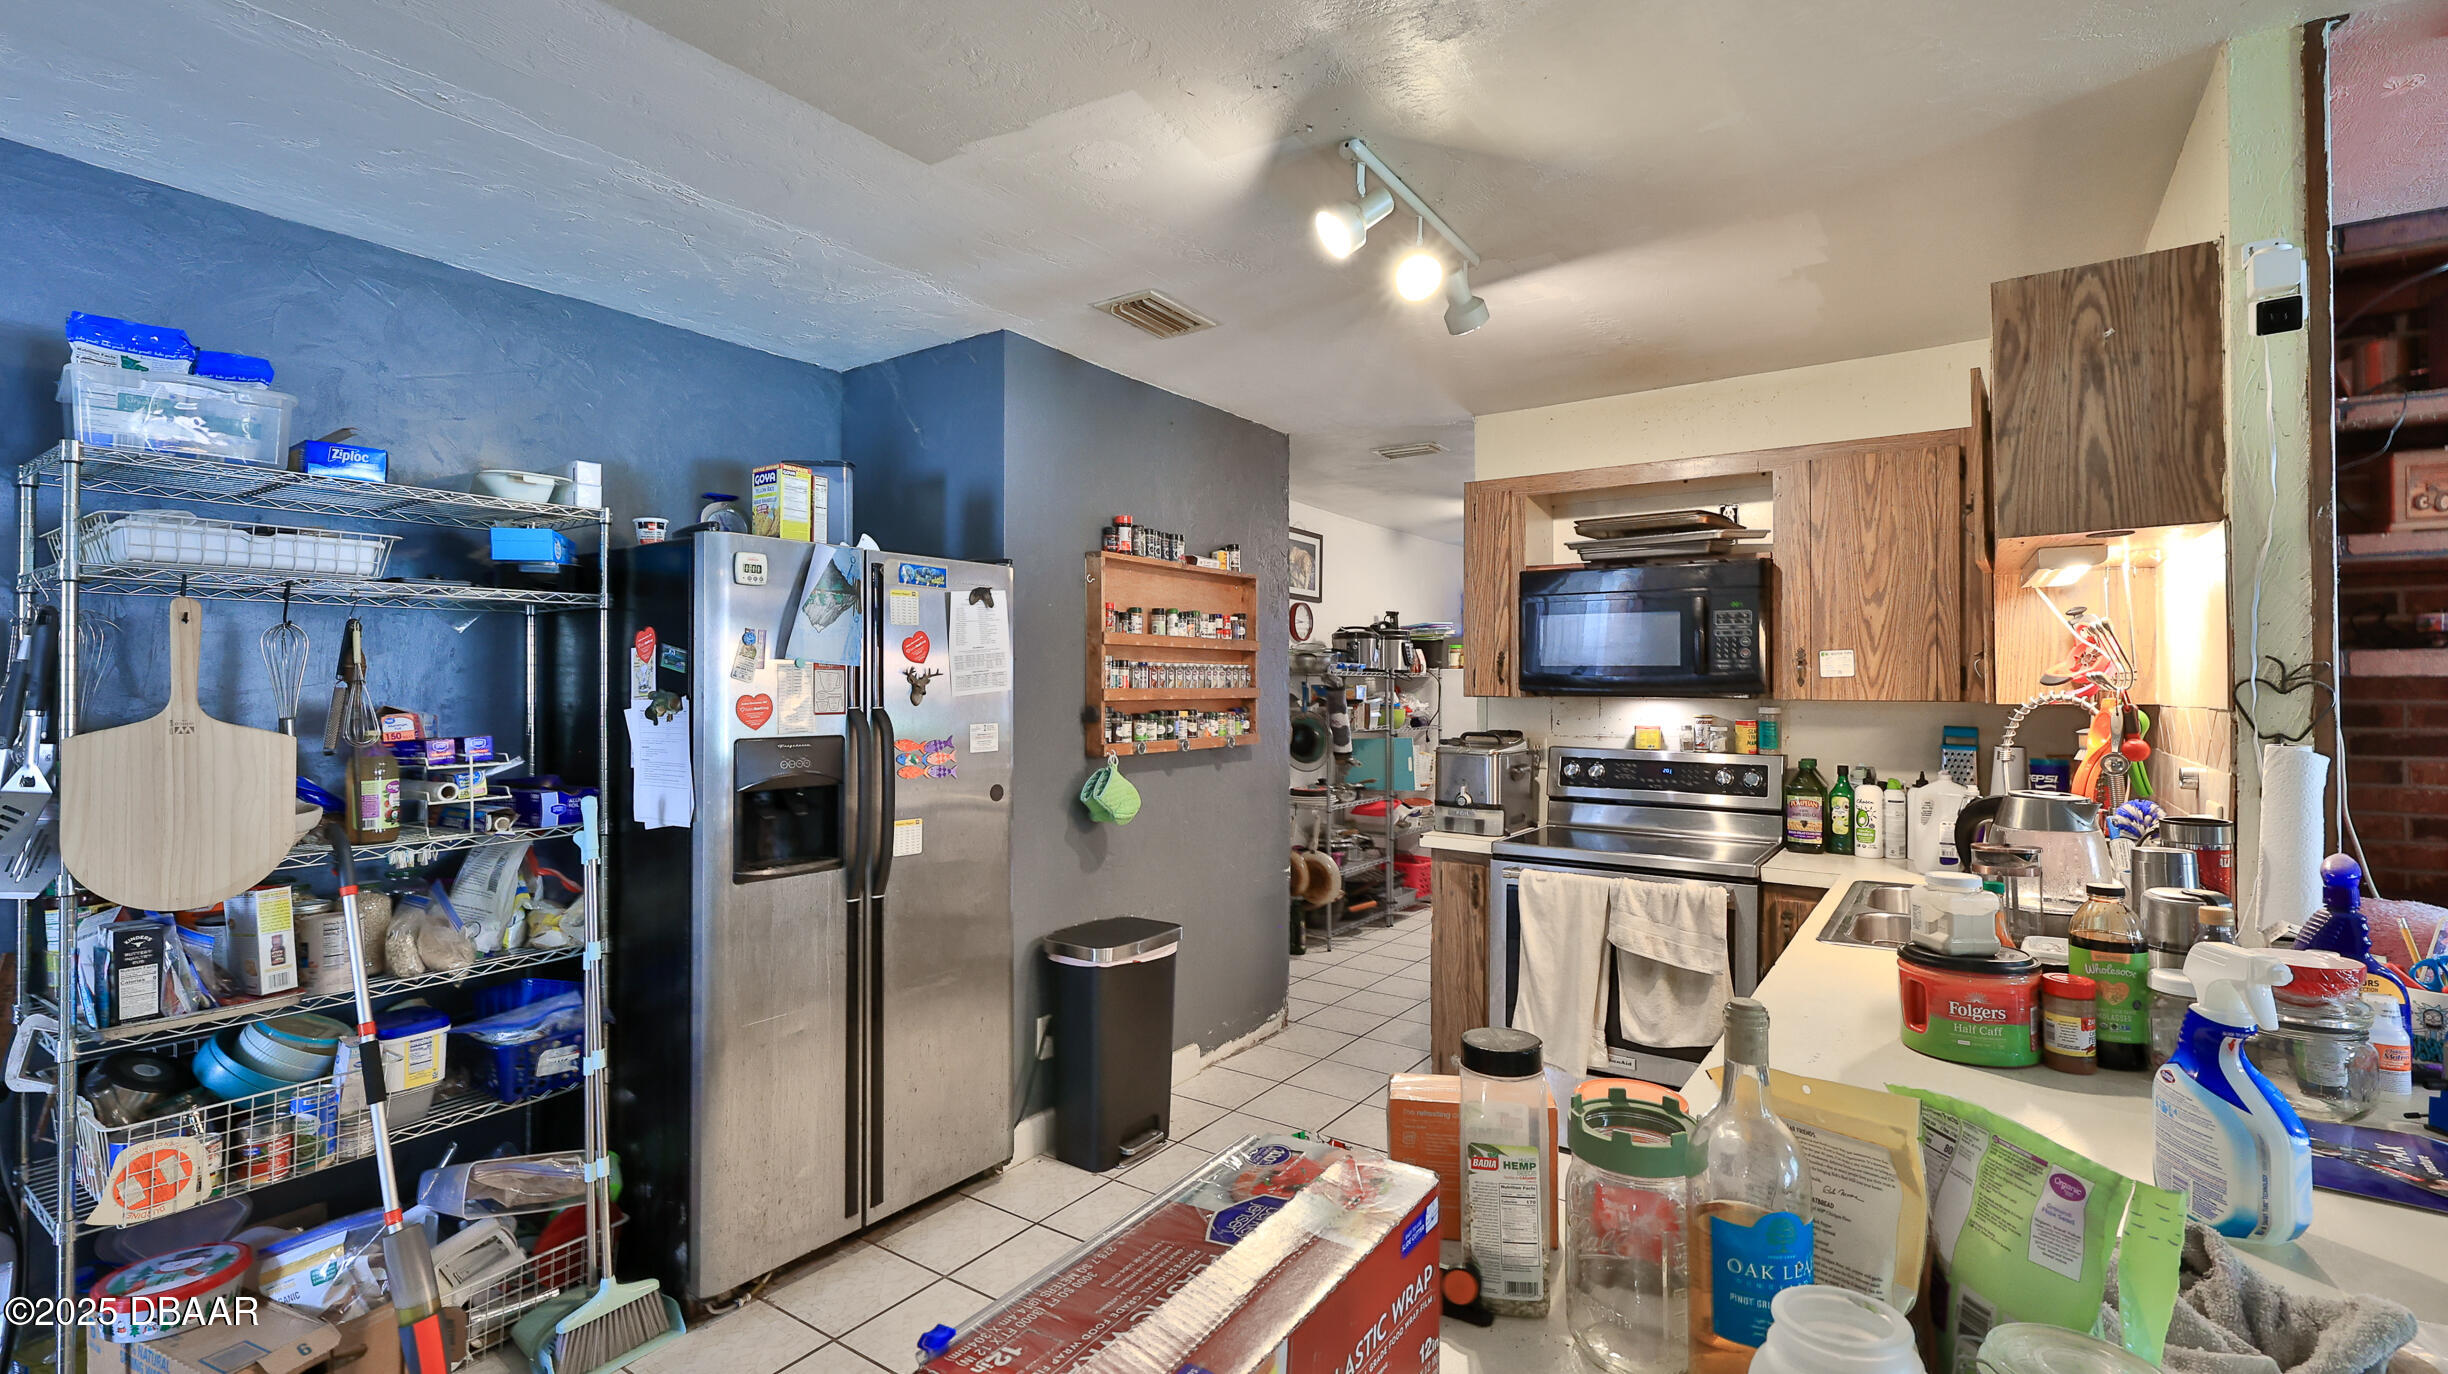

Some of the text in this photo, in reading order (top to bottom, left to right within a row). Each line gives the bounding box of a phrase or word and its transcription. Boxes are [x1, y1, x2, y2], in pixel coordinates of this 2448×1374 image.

[331, 448, 369, 463] Ziploc
[754, 472, 776, 485] GOYA
[385, 732, 402, 740] 150
[2029, 774, 2059, 784] EPSI
[2362, 979, 2380, 987] URS
[1949, 1001, 2007, 1021] Folgers
[1953, 1023, 2003, 1036] Half Caff
[1943, 1144, 1954, 1155] 80
[1472, 1158, 1497, 1169] BADIA
[1503, 1161, 1537, 1170] HEMP
[2054, 1177, 2082, 1196] Organic
[1227, 1202, 1264, 1232] jensen
[1143, 1250, 1201, 1295] PROFESSIONAL
[1727, 1258, 1774, 1280] OAK
[1783, 1258, 1814, 1280] LEA
[1040, 1273, 1080, 1298] METERS
[1071, 1271, 1098, 1289] 3000
[1044, 1297, 1060, 1308] FT
[1109, 1295, 1142, 1319] GRADE
[1729, 1292, 1771, 1309] PINOT GRI
[1334, 1264, 1433, 1374] ASTIC WRAP
[1081, 1318, 1111, 1341] FOOD
[1368, 1295, 1433, 1372] GRADE FOOD WRAP FILM
[296, 1342, 313, 1356] 6
[944, 1332, 992, 1361] 304mm)
[1051, 1341, 1083, 1365] WRAP
[1419, 1336, 1439, 1363] 12in
[137, 1344, 170, 1373] NATURAL
[970, 1346, 1023, 1374] 12in
